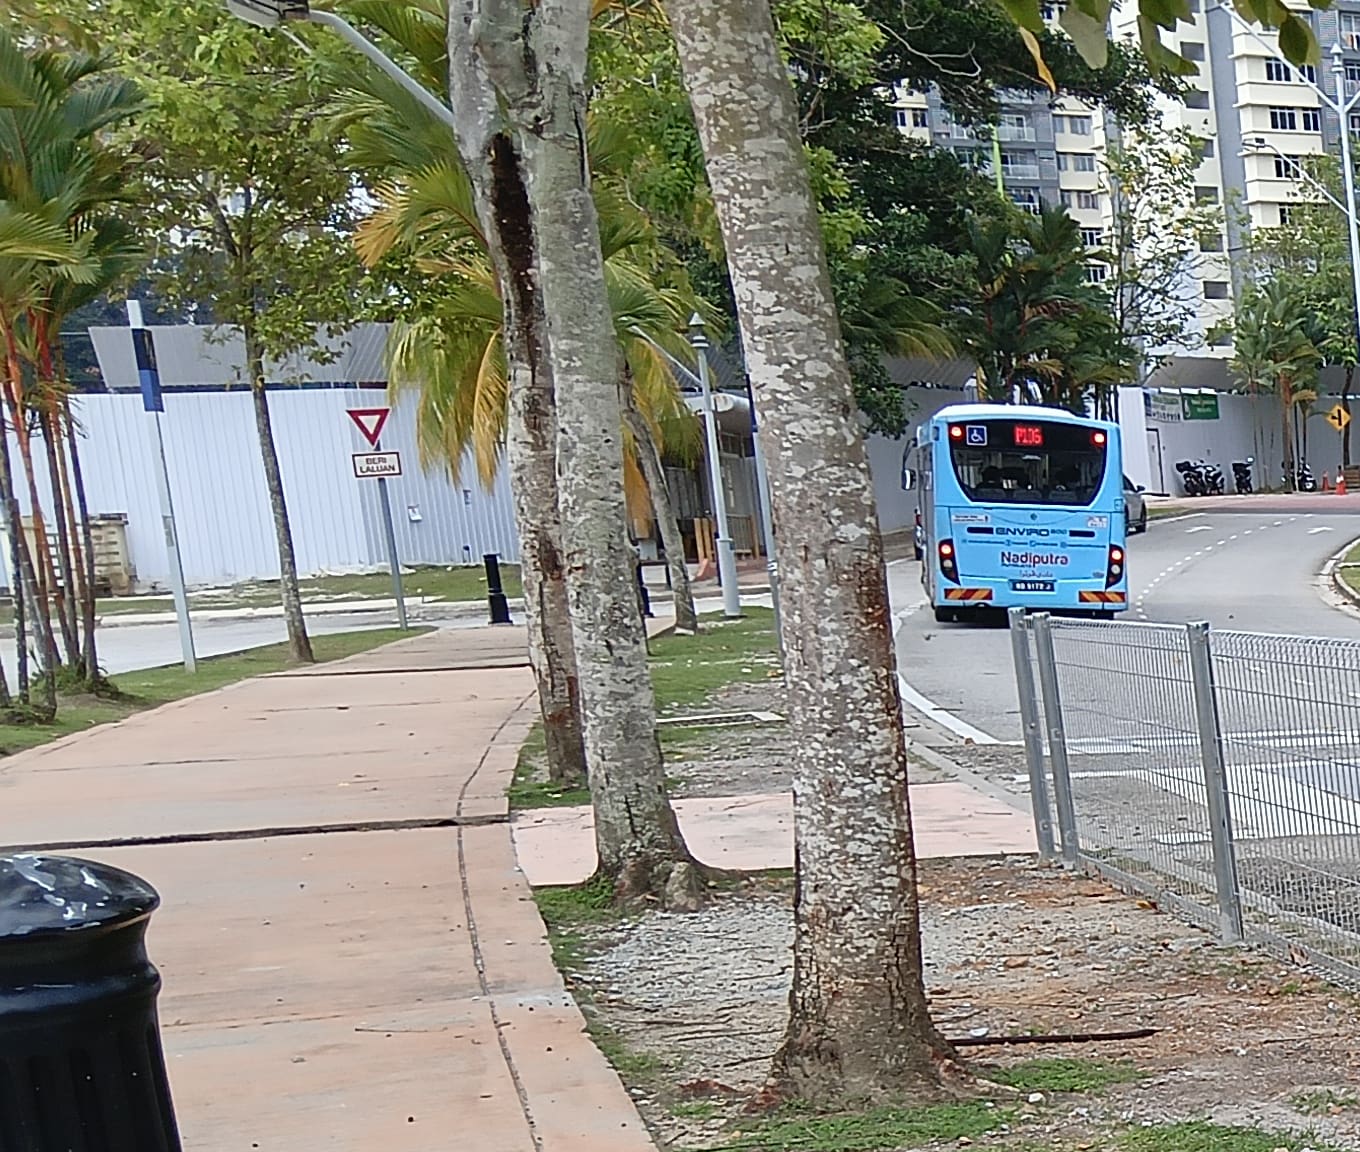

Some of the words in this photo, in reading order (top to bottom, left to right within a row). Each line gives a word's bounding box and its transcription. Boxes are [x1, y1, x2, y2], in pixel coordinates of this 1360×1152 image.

[360, 464, 395, 473] LALUAN
[995, 527, 1050, 537] ENVIRO
[1000, 551, 1069, 568] Nadiputra
